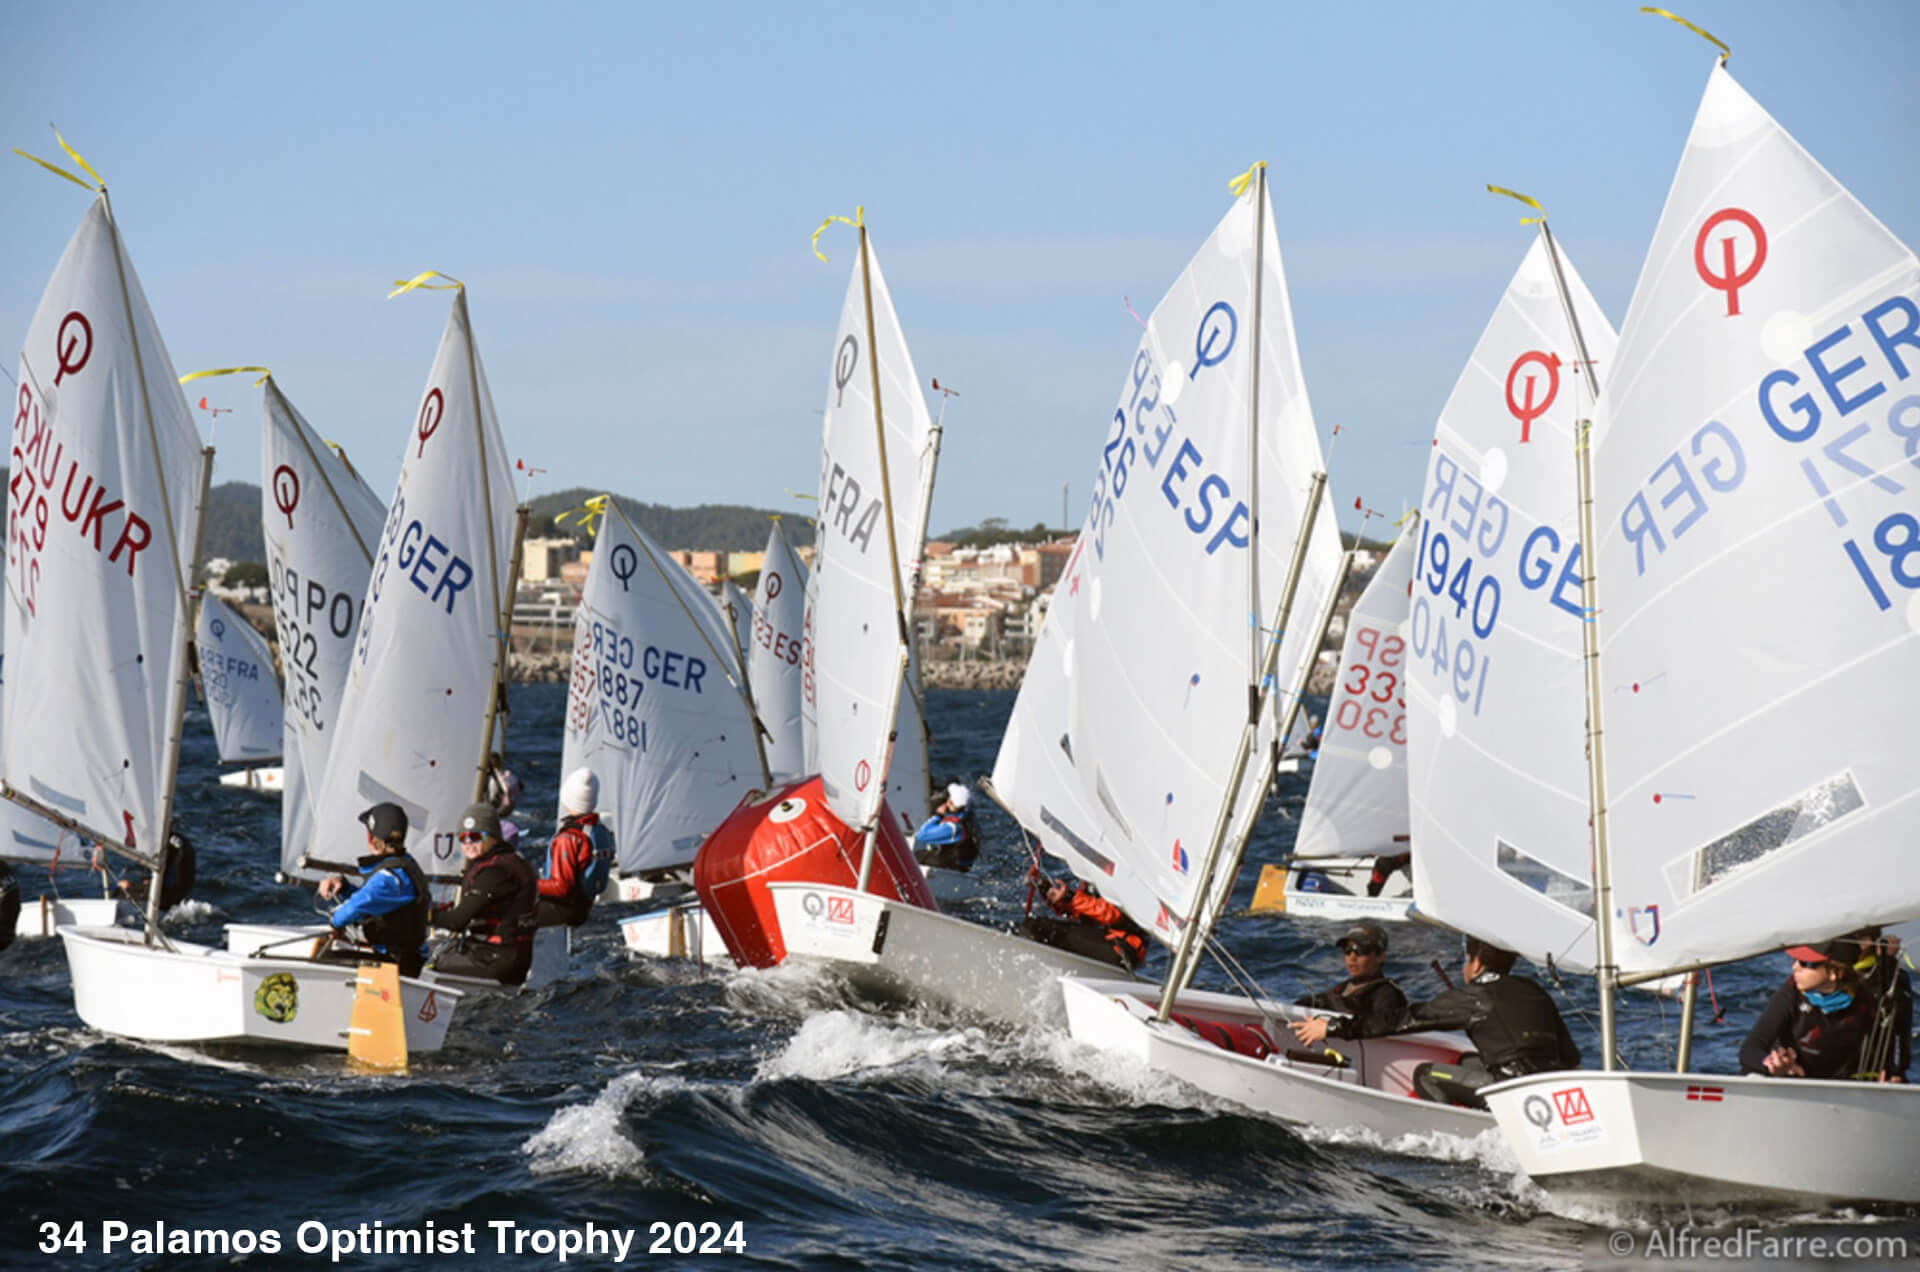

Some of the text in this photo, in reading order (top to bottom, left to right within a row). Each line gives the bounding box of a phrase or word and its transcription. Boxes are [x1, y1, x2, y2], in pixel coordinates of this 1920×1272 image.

[1758, 295, 1920, 443] GER
[1103, 407, 1137, 500] 26
[1160, 437, 1250, 556] ESP
[61, 460, 153, 579] UKR
[823, 460, 883, 555] FRA
[306, 578, 366, 640] PO
[397, 519, 475, 616] GER
[1415, 518, 1502, 640] 1940
[1842, 512, 1920, 613] 18
[226, 657, 259, 682] FRA
[596, 659, 644, 711] 1887
[643, 645, 707, 694] GER
[773, 631, 803, 669] ES
[1344, 664, 1407, 710] 33
